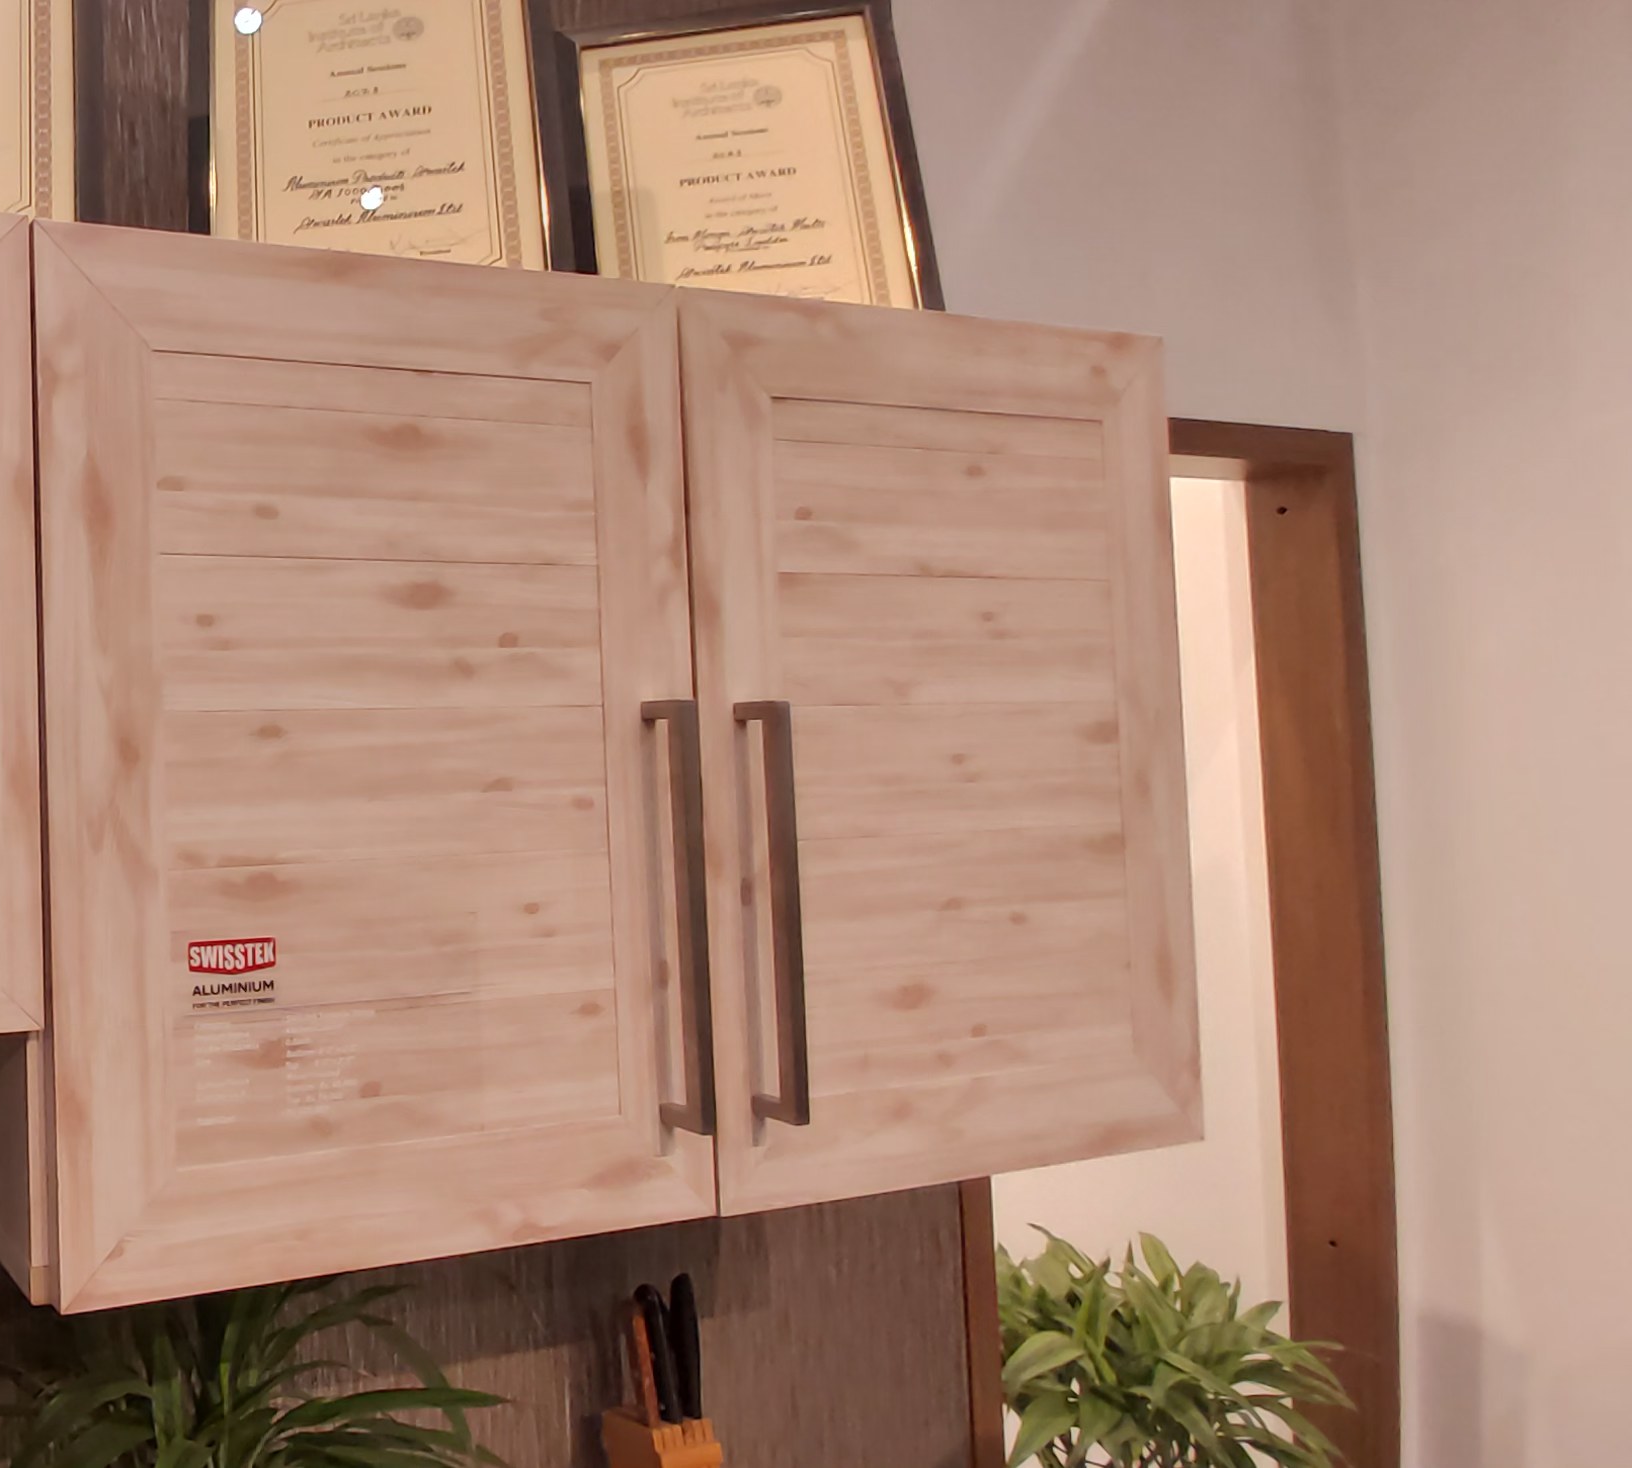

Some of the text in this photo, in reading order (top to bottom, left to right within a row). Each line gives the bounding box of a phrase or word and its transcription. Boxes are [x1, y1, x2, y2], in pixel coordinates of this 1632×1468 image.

[308, 105, 434, 129] PRODUCT AWARD
[679, 166, 798, 187] PRODUCT AWARD
[188, 941, 275, 971] SWISSTEK
[192, 980, 274, 997] ALUMINIUM
[207, 1000, 220, 1008] THE
[222, 999, 252, 1007] PERFECT
